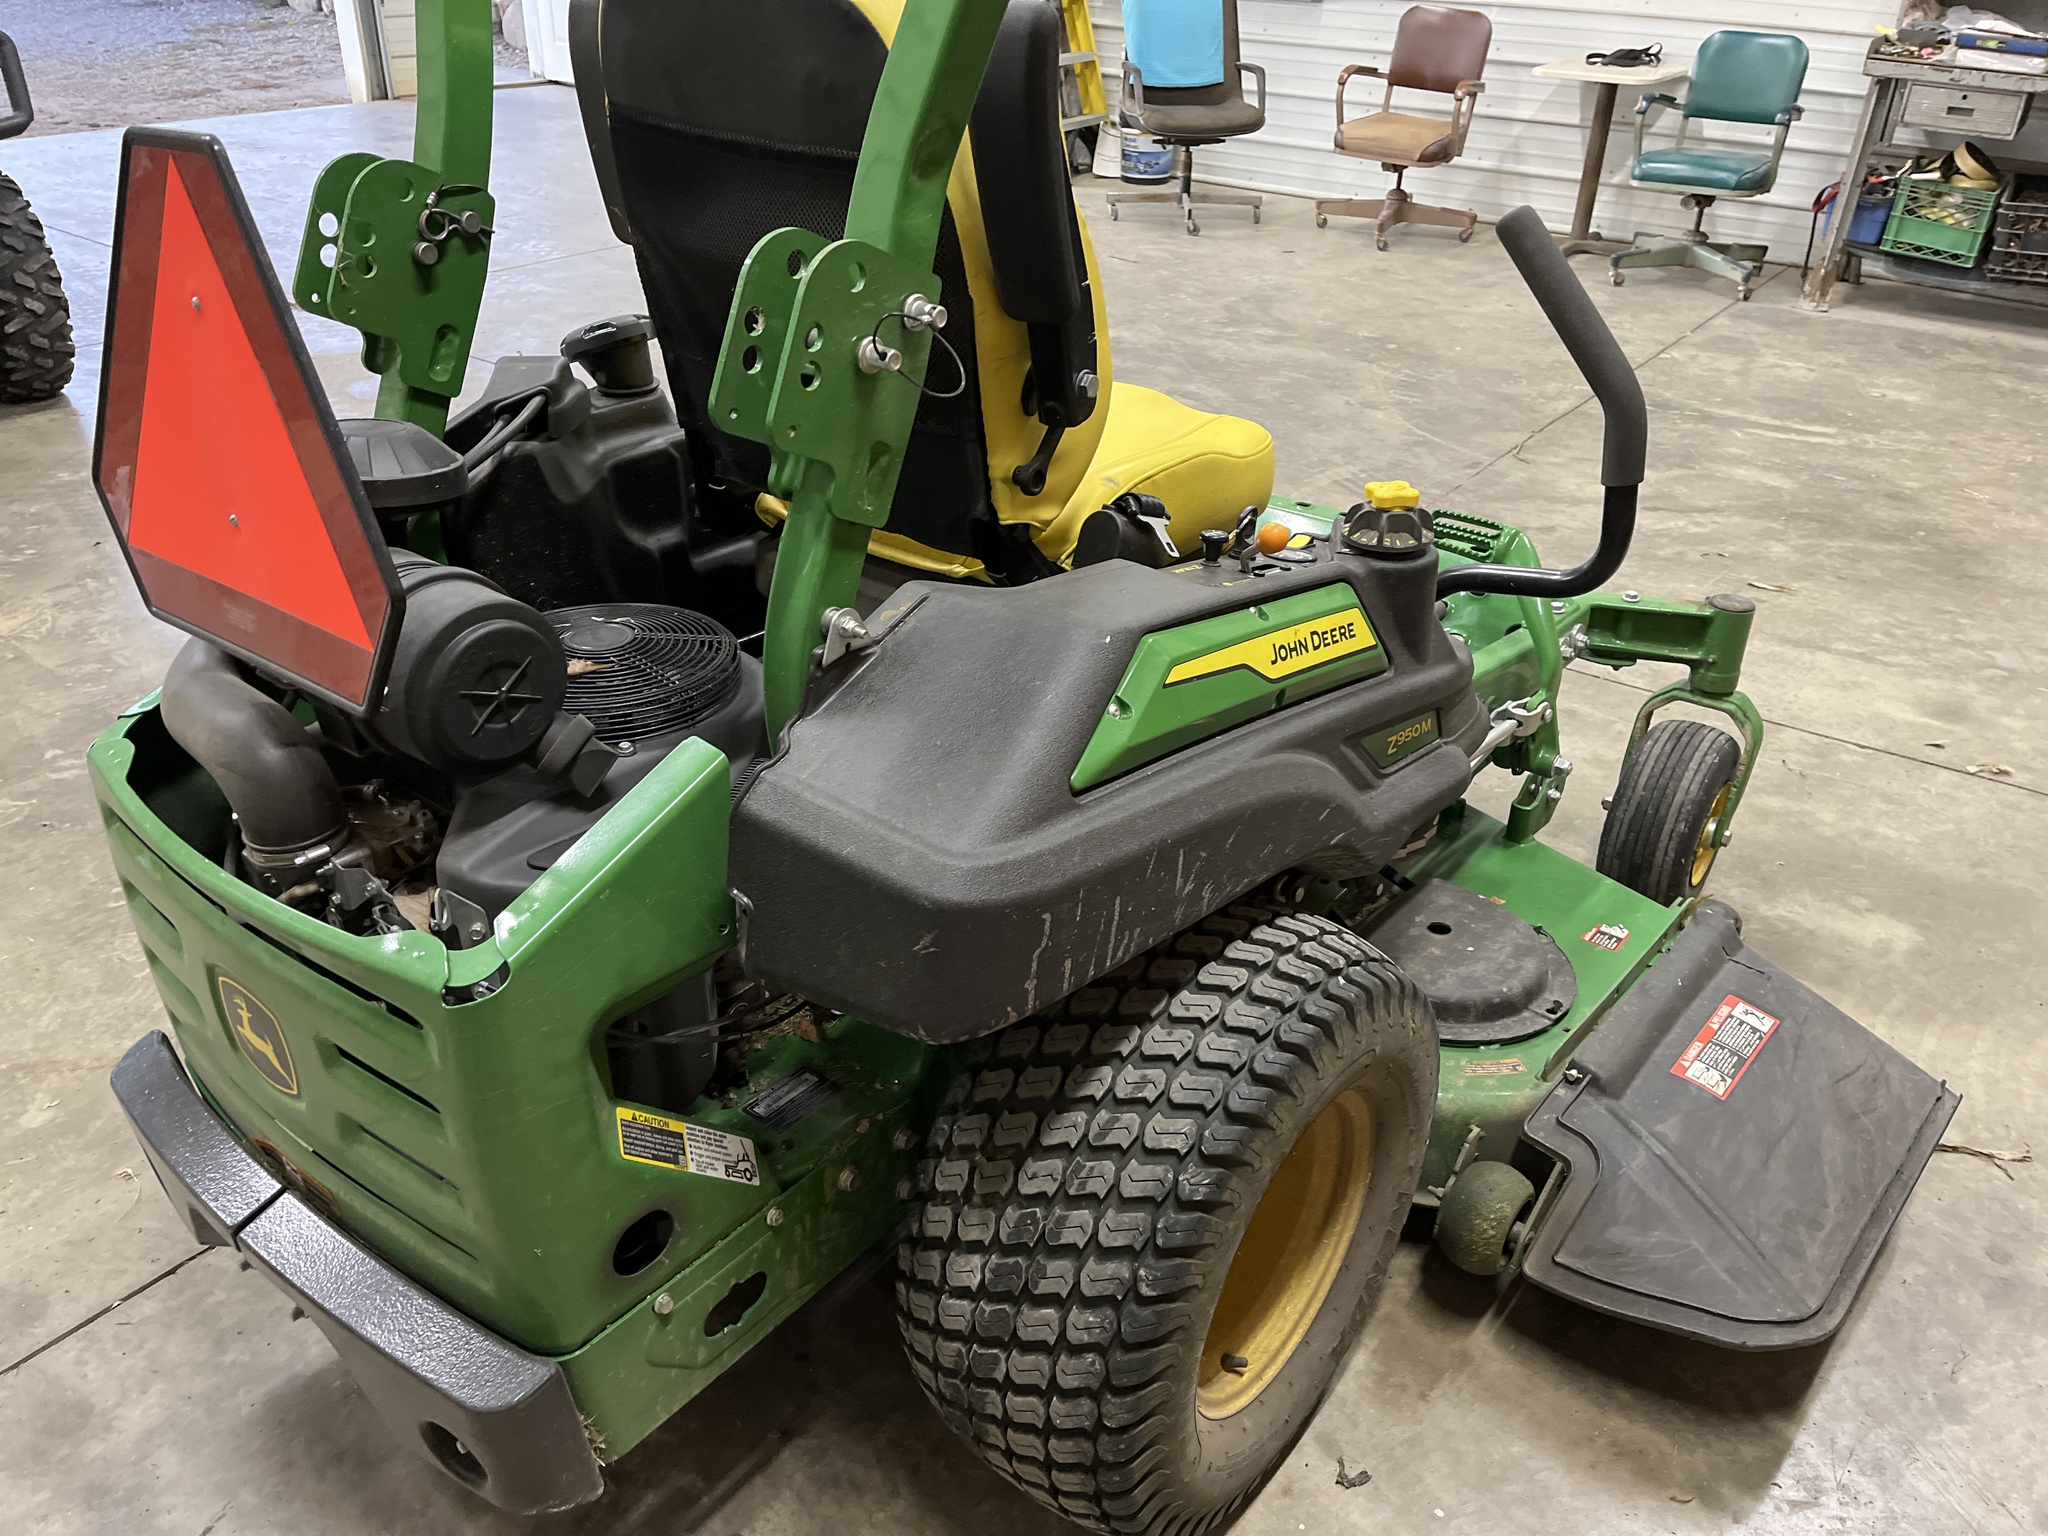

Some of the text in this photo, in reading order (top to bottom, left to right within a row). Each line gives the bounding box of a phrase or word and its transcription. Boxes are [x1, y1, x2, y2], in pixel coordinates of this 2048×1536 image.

[1270, 622, 1356, 666] JOHN DEERE
[1387, 718, 1432, 755] Z950M
[638, 1114, 670, 1130] CAUTION
